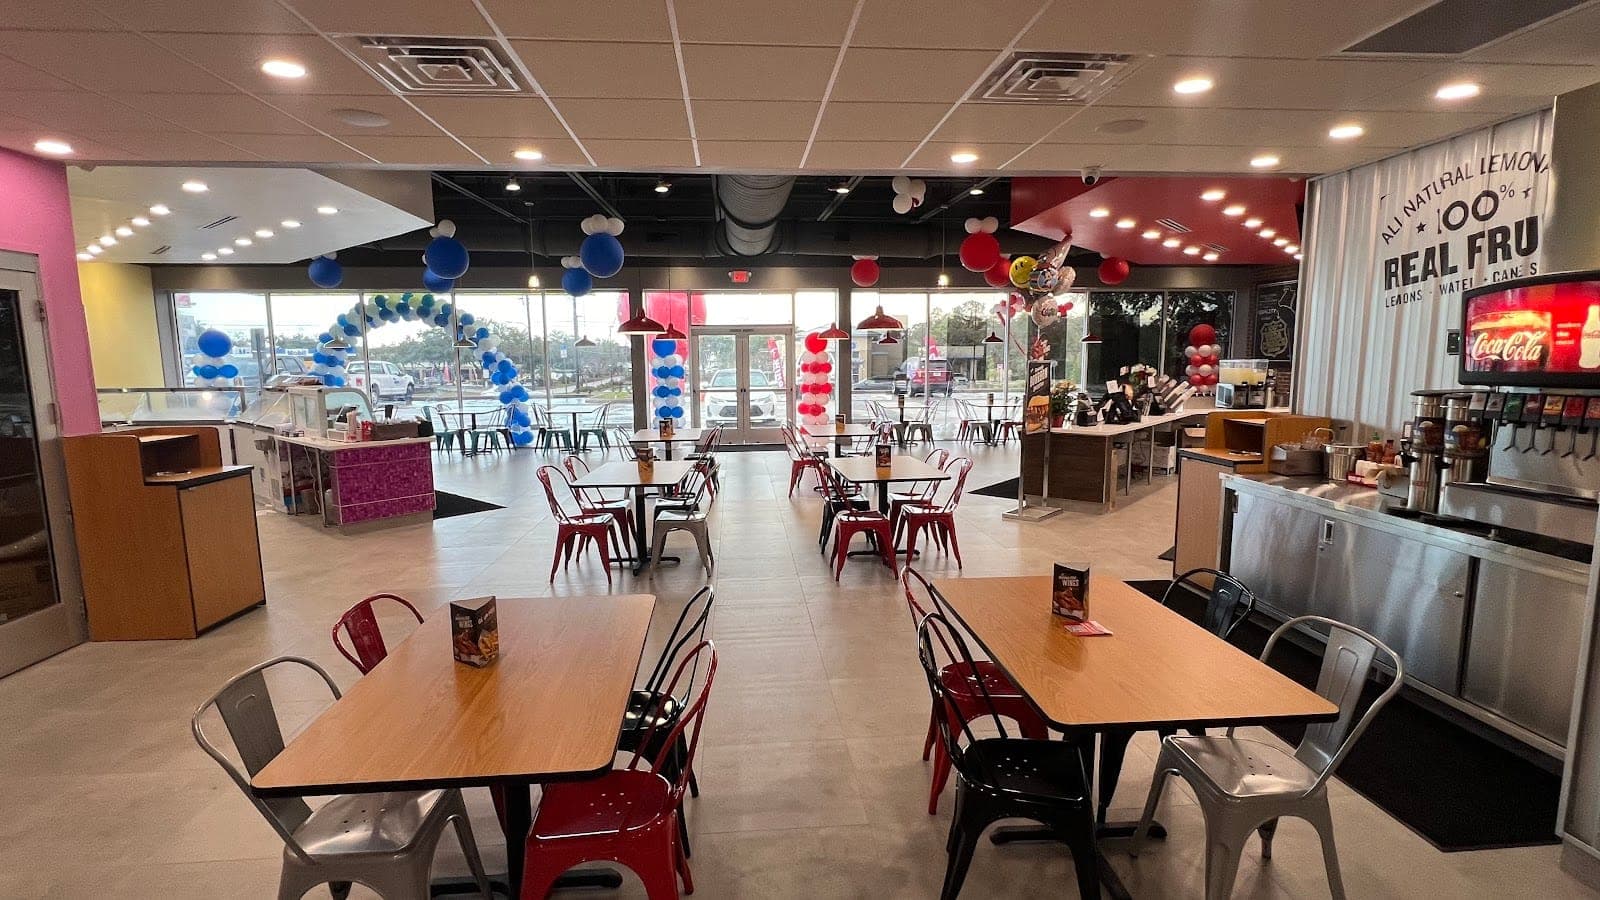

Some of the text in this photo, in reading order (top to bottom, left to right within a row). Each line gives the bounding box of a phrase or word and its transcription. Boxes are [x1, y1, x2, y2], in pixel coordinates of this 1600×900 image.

[1384, 215, 1539, 291] REAL FRU
[1471, 331, 1546, 361] Coca-Cola
